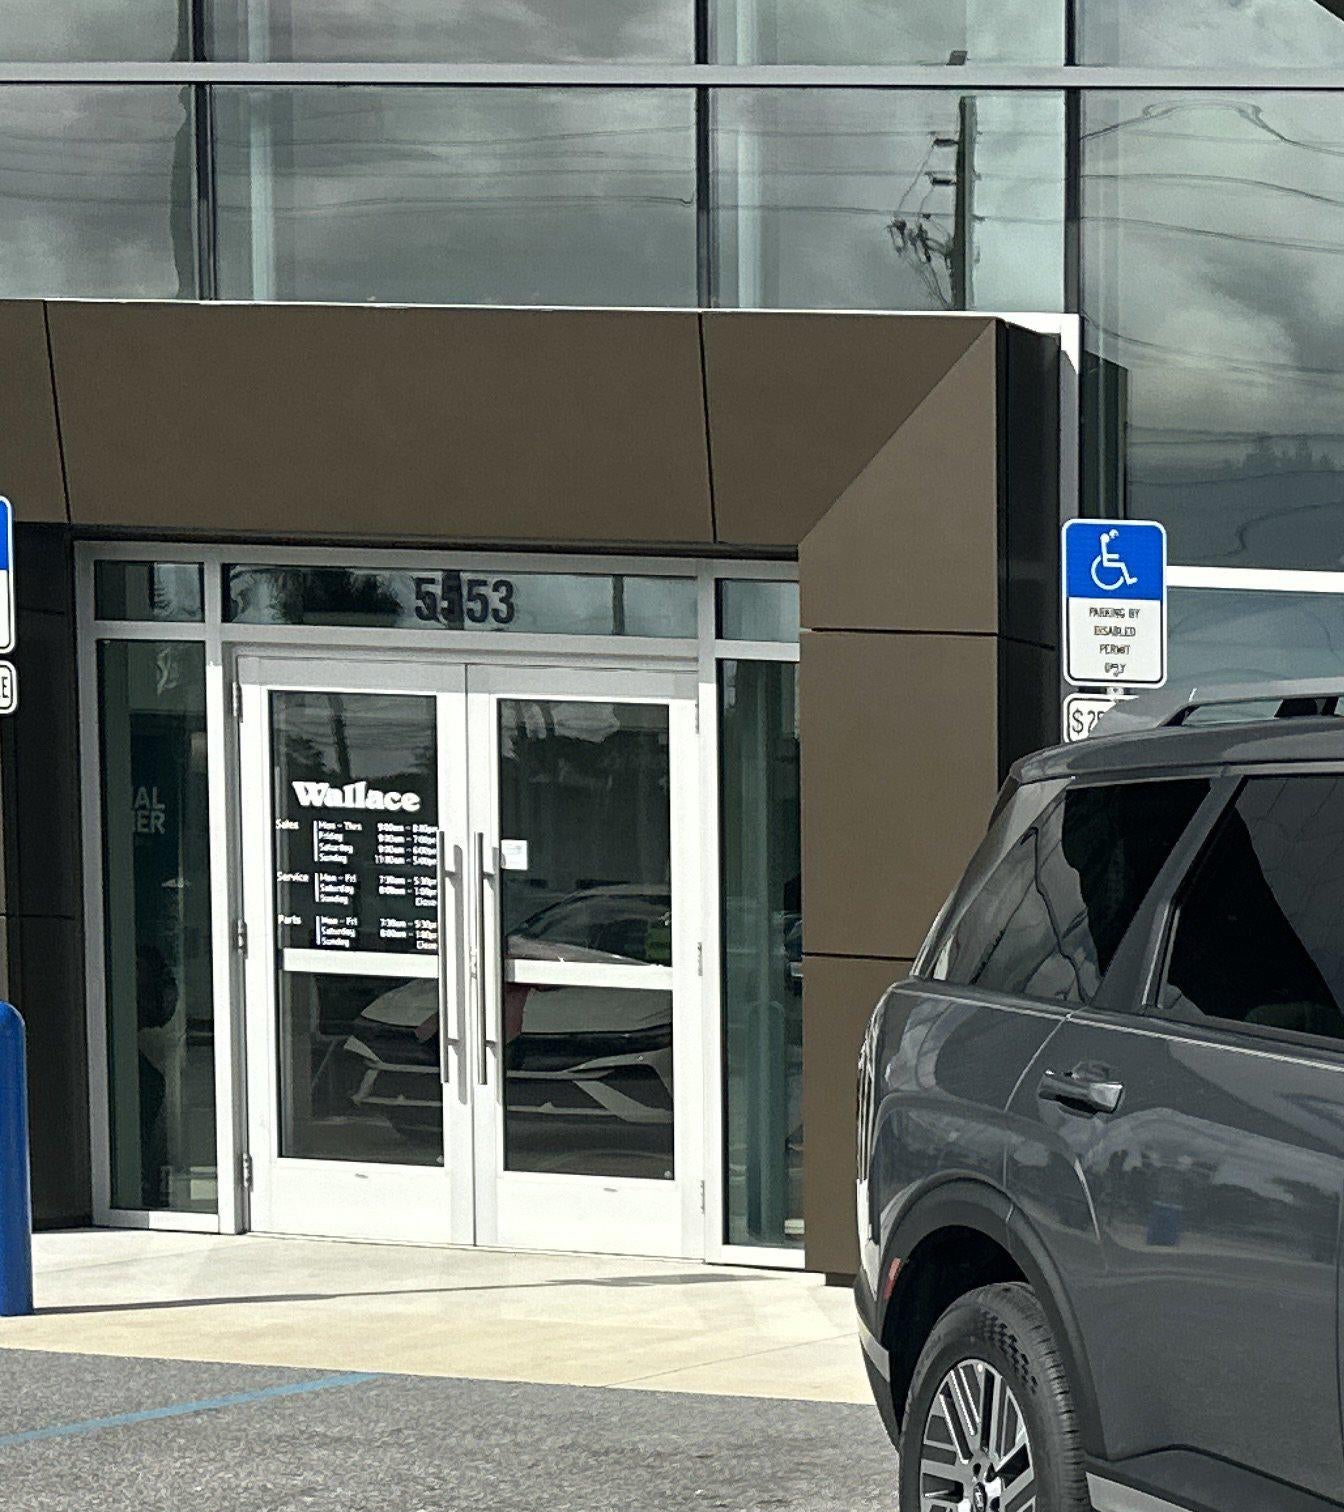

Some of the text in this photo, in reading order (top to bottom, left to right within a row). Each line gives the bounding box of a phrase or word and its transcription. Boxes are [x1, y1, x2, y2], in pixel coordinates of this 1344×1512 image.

[1089, 607, 1140, 619] PARKING BY
[1094, 626, 1136, 637] DISABLED
[1099, 644, 1130, 655] PERMIT
[292, 781, 421, 812] Wallace
[277, 871, 309, 882] Service
[320, 883, 354, 894] Saturday
[320, 894, 348, 904] Sunday
[278, 914, 301, 924] Parts
[321, 926, 355, 937] Saturday
[322, 937, 349, 948] Sunday
